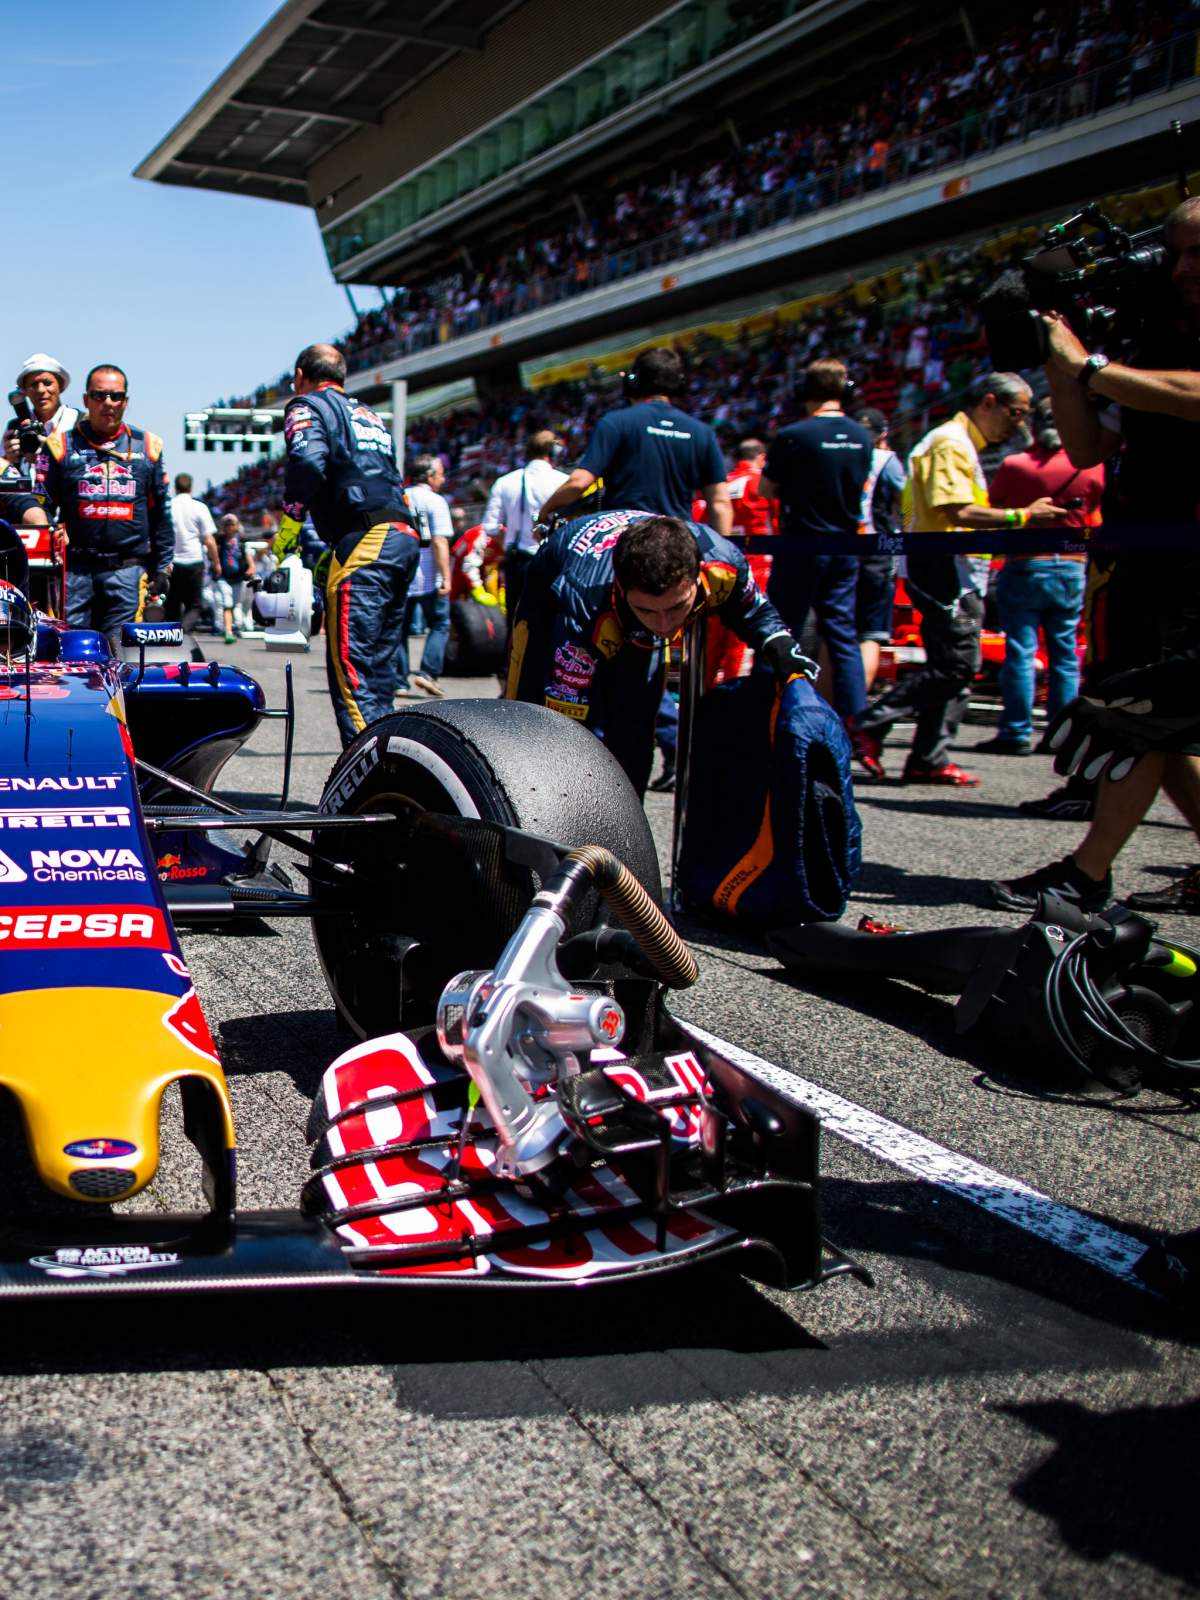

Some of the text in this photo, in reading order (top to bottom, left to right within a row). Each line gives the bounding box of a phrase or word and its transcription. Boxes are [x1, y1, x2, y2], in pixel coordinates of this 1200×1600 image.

[78, 479, 137, 497] Red Bull
[30, 849, 143, 868] NOVA
[33, 867, 147, 882] Chemicals
[170, 865, 208, 880] Rosso
[601, 1010, 621, 1037] 33
[81, 1255, 122, 1265] ROAD
[123, 1253, 178, 1263] SAFETY
[84, 1246, 150, 1257] ACTION
